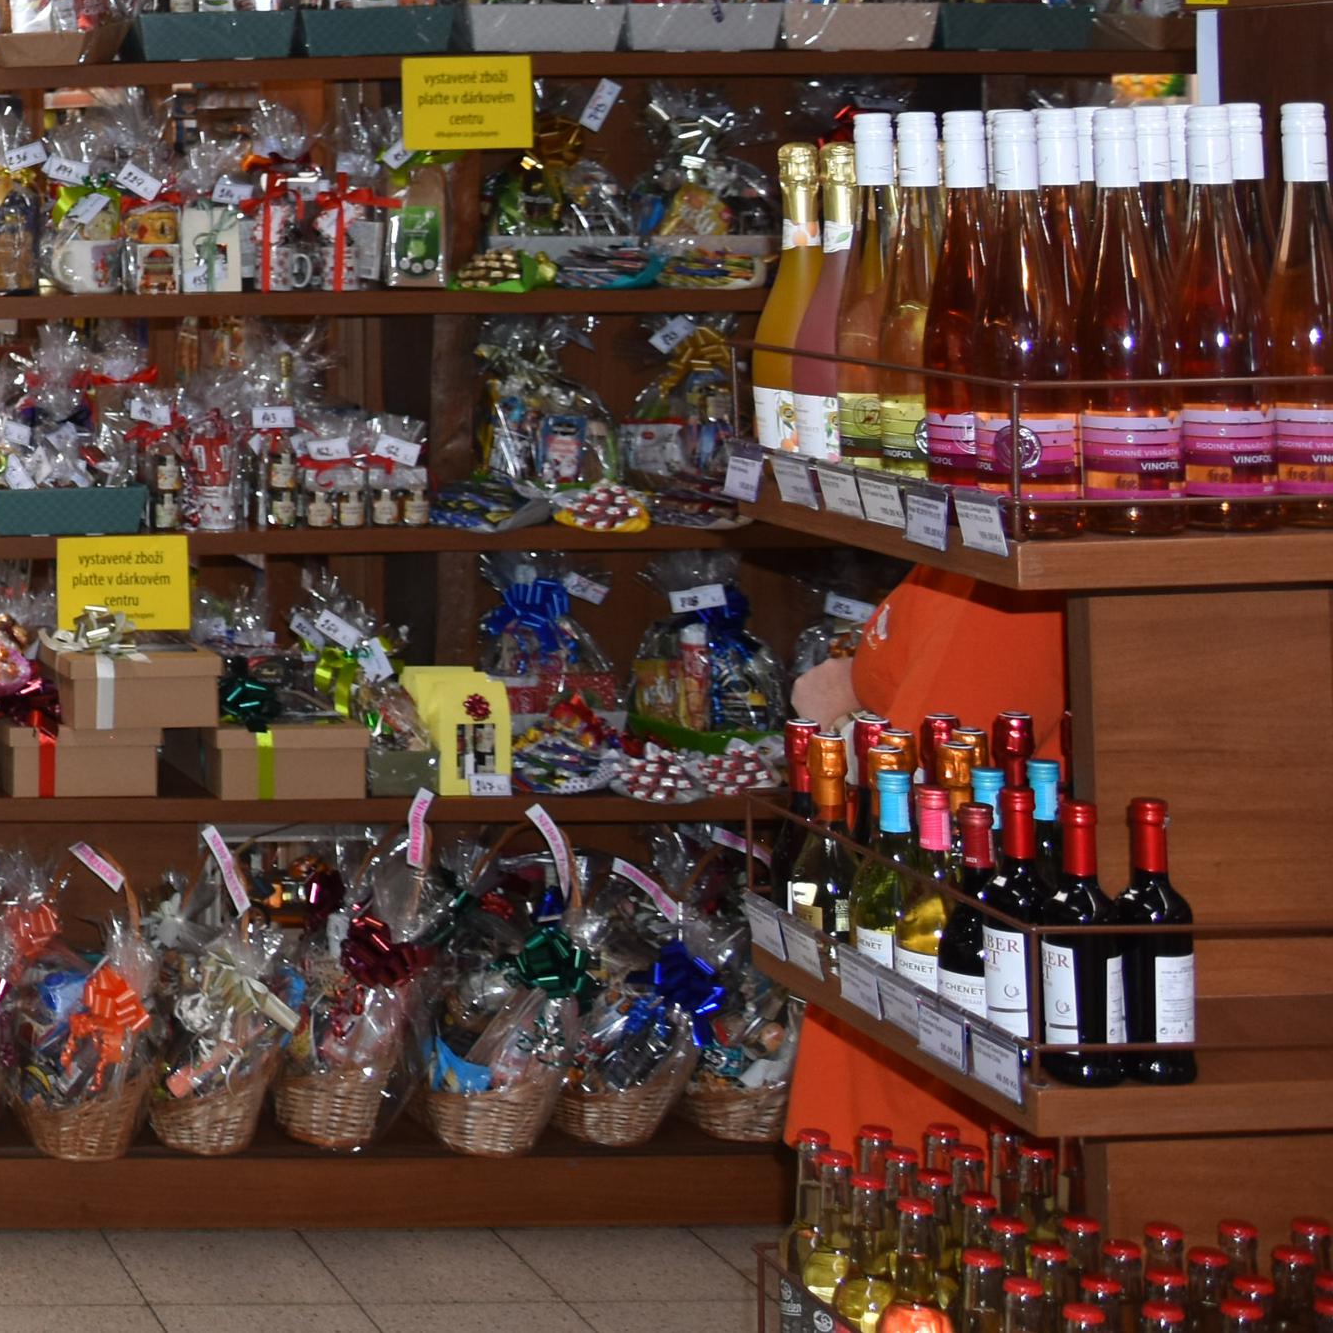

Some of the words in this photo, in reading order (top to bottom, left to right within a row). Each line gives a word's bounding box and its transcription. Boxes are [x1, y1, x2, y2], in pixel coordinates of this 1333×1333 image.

[423, 72, 478, 87] vystavené
[480, 70, 508, 84] zboží
[460, 92, 515, 105] dárkovém
[449, 113, 485, 126] centru
[1233, 454, 1273, 464] VINOFOL
[1141, 462, 1180, 471] VINOFOL
[78, 553, 132, 567] vystavené
[134, 550, 164, 564] zboží
[72, 573, 104, 587] plaťte
[106, 576, 113, 584] v
[115, 573, 170, 585] dárkovém
[104, 595, 139, 607] centru
[900, 960, 935, 975] CHENET
[945, 981, 985, 996] CHENET
